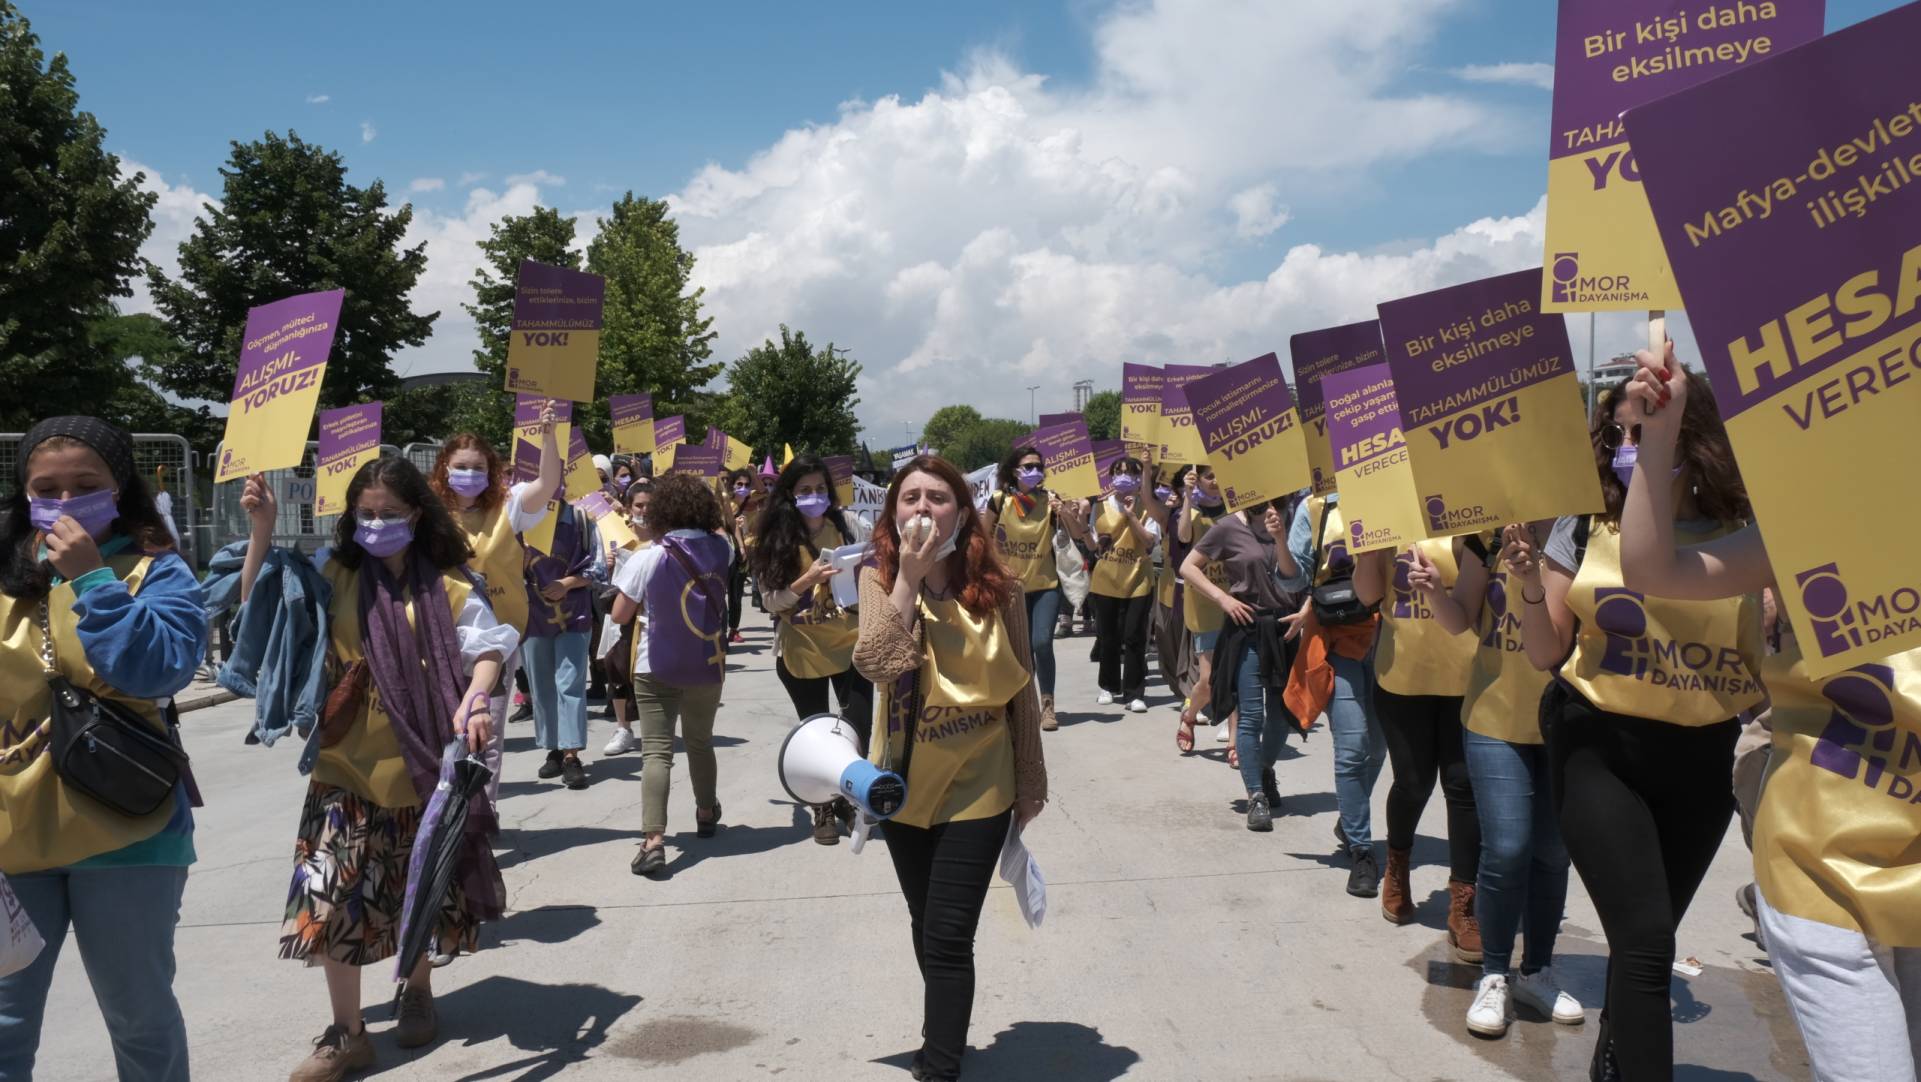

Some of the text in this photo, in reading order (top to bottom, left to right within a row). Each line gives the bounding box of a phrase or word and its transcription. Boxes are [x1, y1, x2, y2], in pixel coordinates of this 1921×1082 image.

[1584, 1, 1777, 59] Bir kişi daha
[1612, 36, 1772, 83] eksilmeye
[1579, 276, 1630, 291] MOR
[1579, 291, 1649, 303] DAYANIŞMA
[264, 322, 328, 353] düşmanlığınıza
[282, 312, 315, 332] mülteci
[1405, 300, 1531, 357] Bir kişi daha
[523, 332, 569, 346] YOK!
[1431, 324, 1535, 373] eksilmeye
[239, 350, 301, 393] ALIŞMI-
[244, 368, 319, 414] YORUZ!
[1197, 377, 1262, 417] Çocuk istismarını
[1205, 378, 1279, 422] normalleştirmenize
[1330, 387, 1361, 409] Doğal
[1409, 356, 1561, 423] TAHAMMÜLÜMÜZ
[615, 415, 640, 426] HESAP
[1129, 404, 1157, 414] YOK!
[1334, 403, 1362, 422] çekip
[1351, 410, 1376, 427] gasp
[1429, 396, 1521, 450] YOK!
[1209, 406, 1267, 447] ALIŞMI-
[1222, 413, 1293, 461] YORUZ!
[326, 456, 357, 476] YOK!
[1051, 455, 1092, 475] YORUZ!
[1449, 505, 1484, 521] MOR
[1366, 528, 1391, 538] MOR
[1653, 639, 1742, 675] MOR
